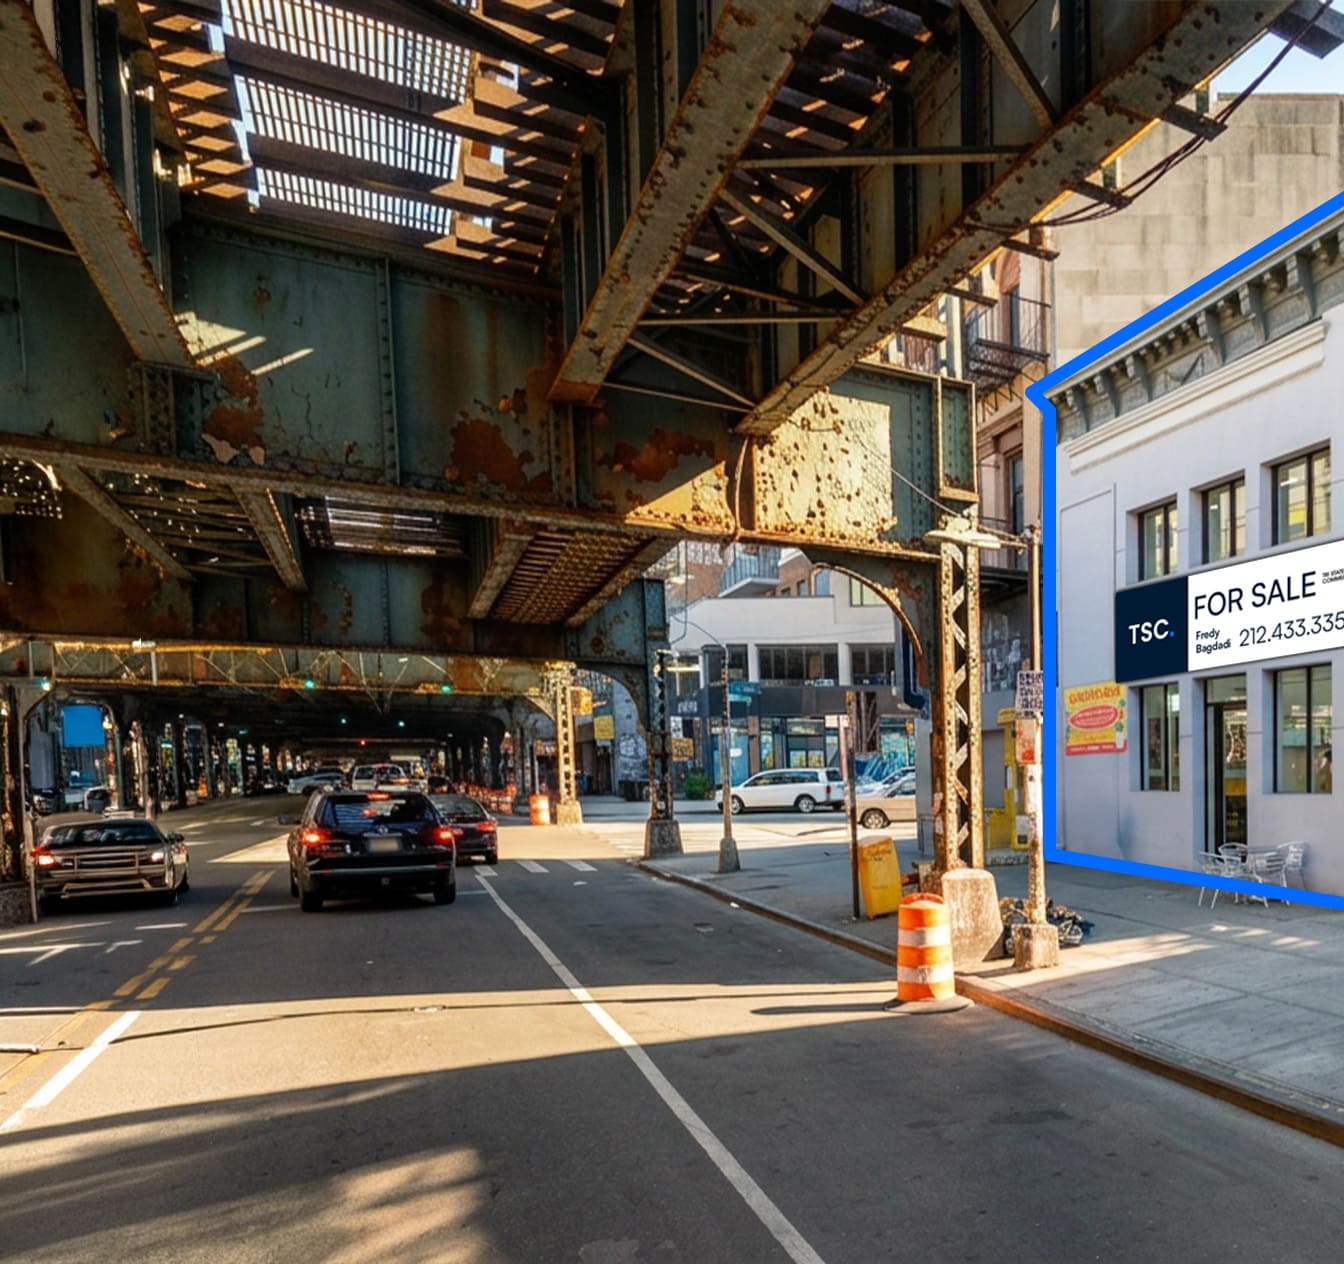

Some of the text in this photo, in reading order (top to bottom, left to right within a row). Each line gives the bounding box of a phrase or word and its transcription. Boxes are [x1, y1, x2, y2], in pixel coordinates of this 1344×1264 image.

[1194, 570, 1317, 620] FOR SALE
[1195, 627, 1221, 641] Fredy
[1195, 638, 1232, 655] Bagdadi
